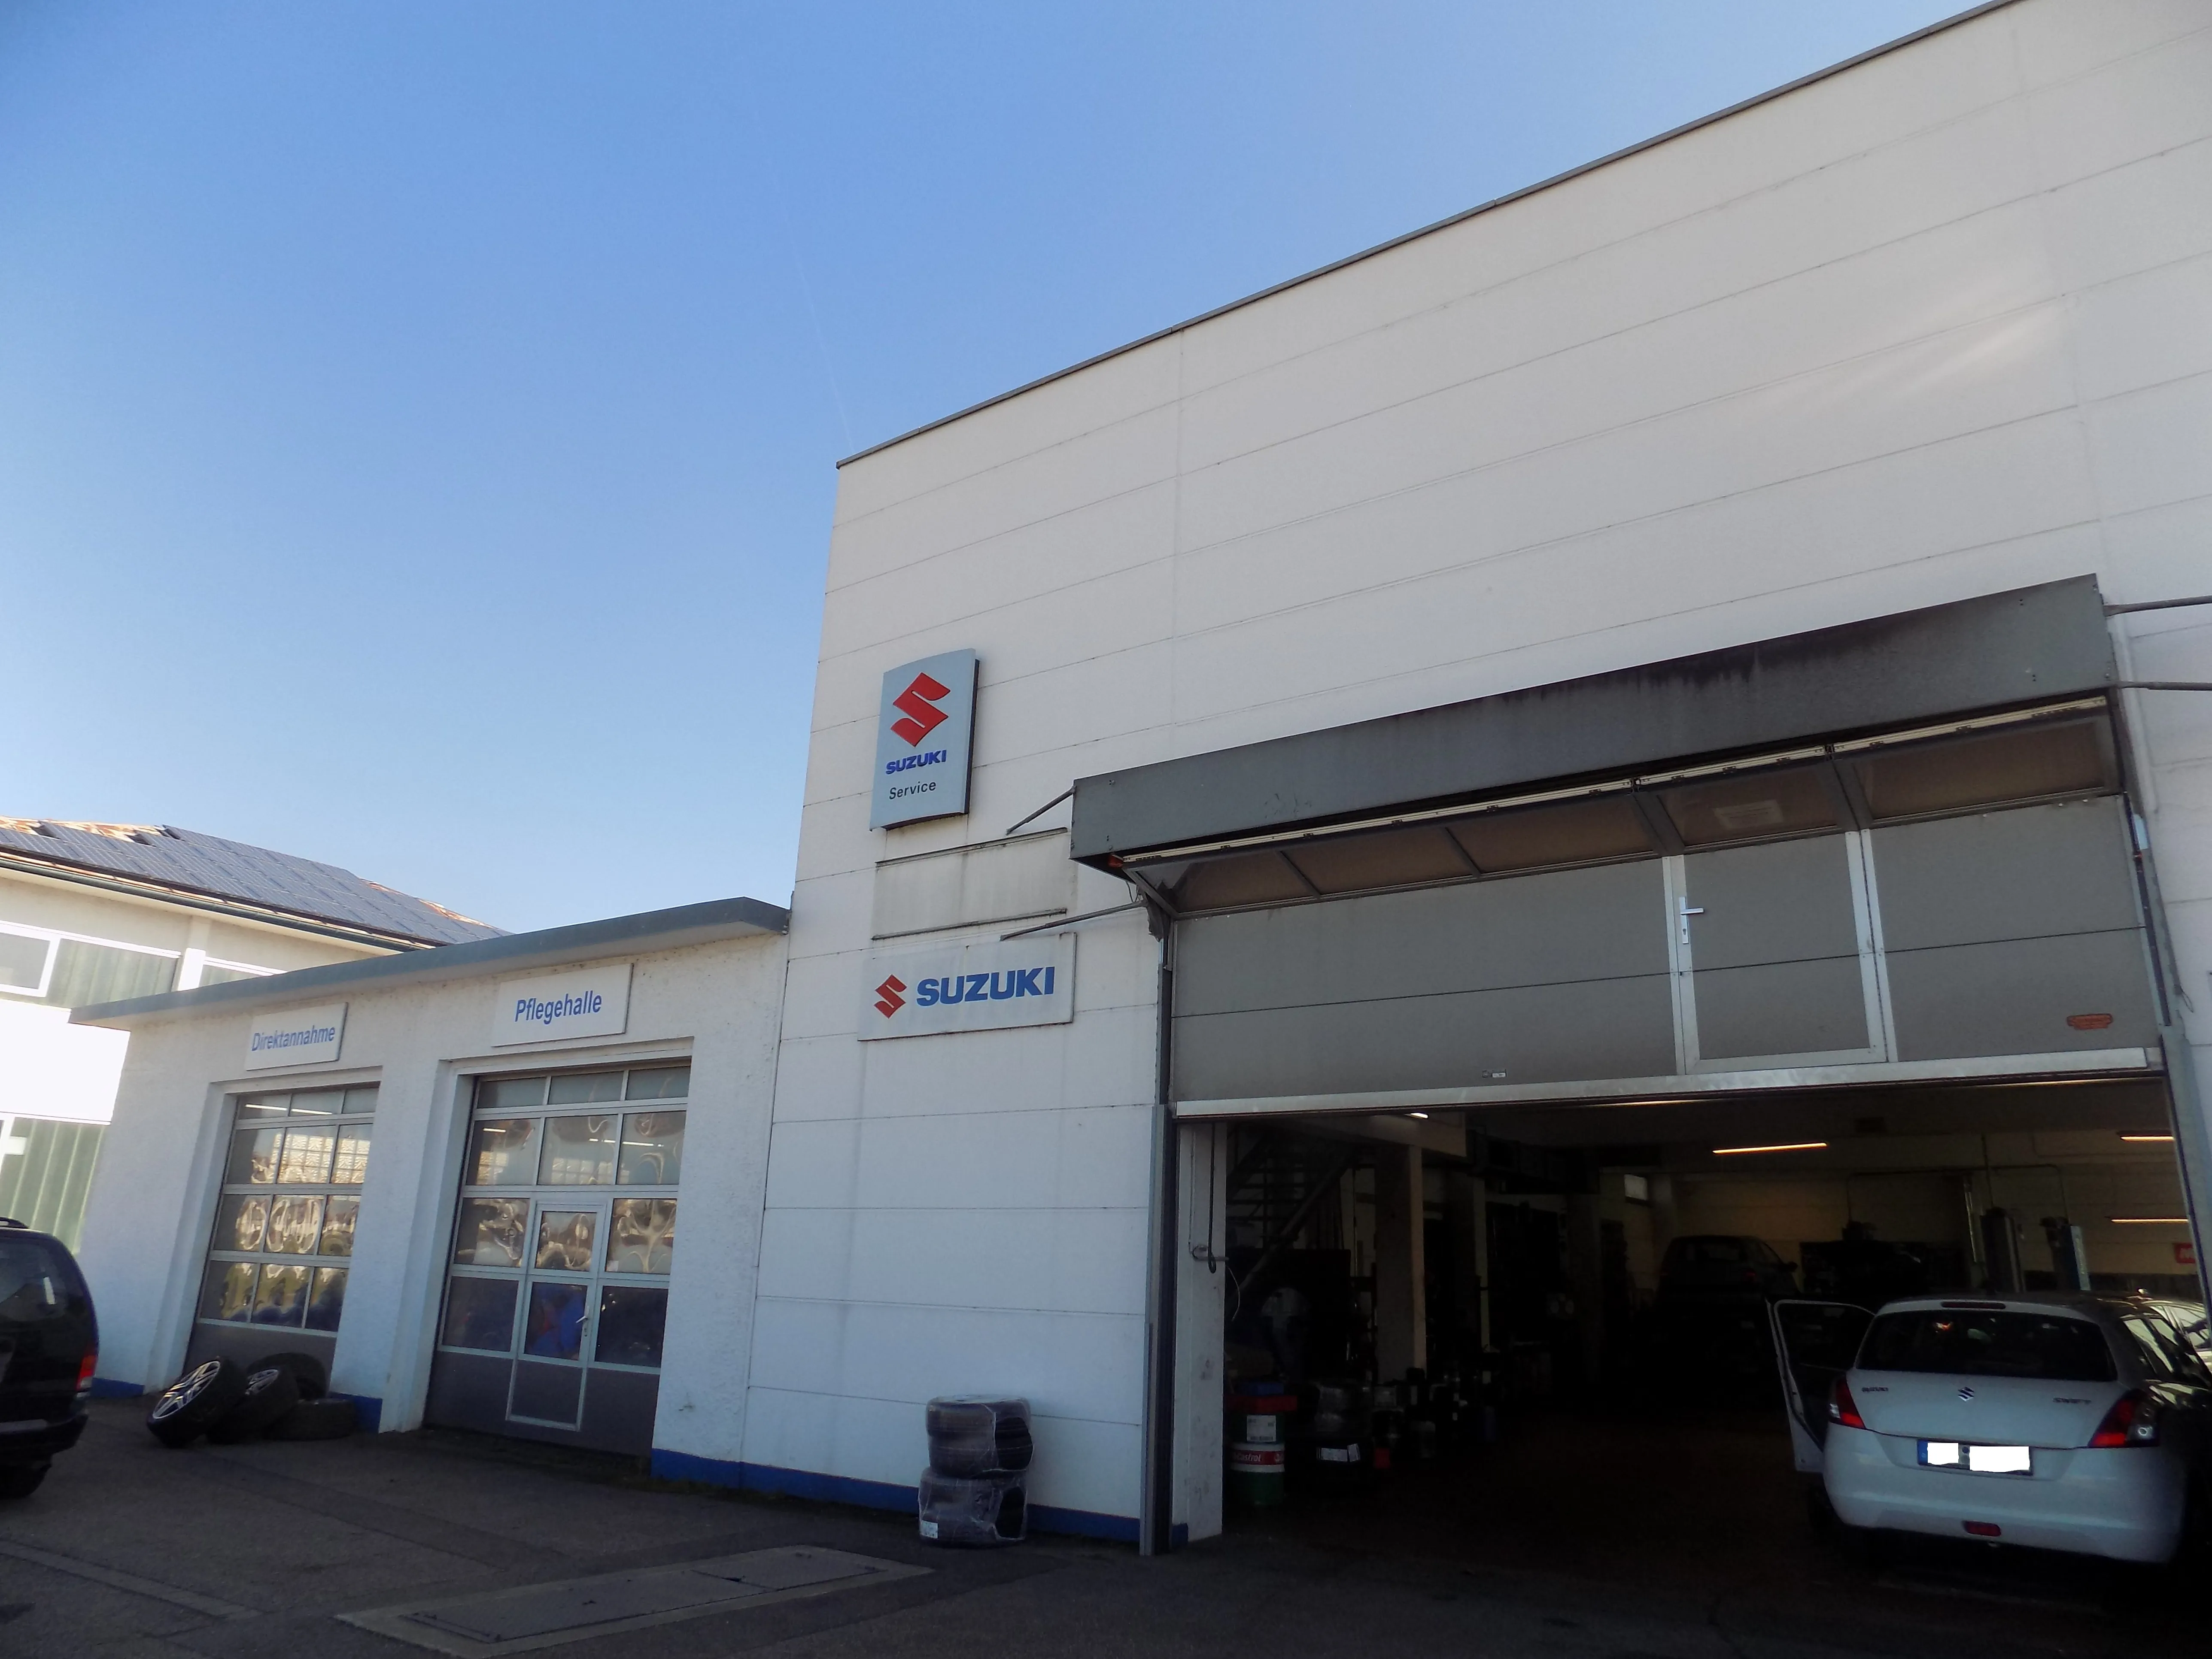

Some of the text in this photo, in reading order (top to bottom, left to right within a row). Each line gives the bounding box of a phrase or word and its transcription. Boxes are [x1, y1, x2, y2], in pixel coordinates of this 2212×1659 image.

[885, 749, 947, 775] SUZUKI
[889, 781, 936, 800] Service
[916, 966, 1055, 1007] SUZUKI
[515, 990, 602, 1025] Pflegehalle
[251, 1025, 335, 1051] Direktannahme
